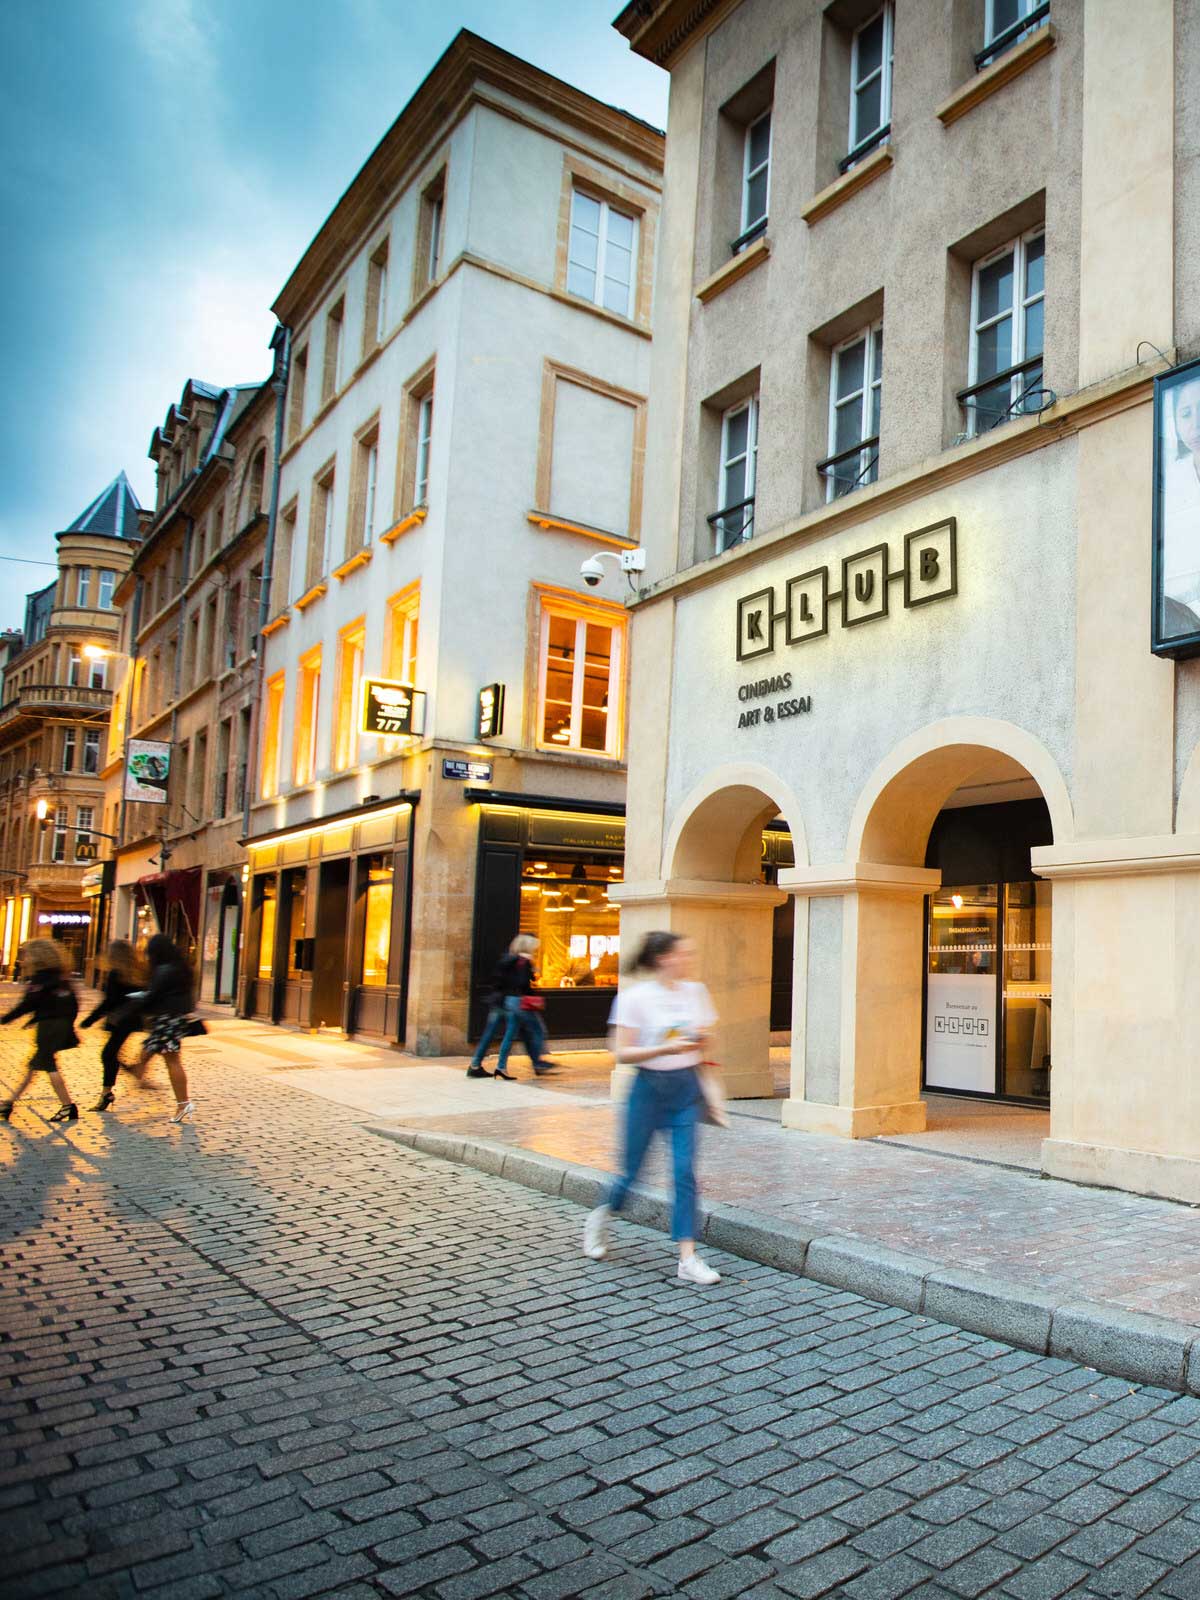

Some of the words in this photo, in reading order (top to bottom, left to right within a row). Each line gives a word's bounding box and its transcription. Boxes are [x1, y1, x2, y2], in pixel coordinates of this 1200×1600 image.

[743, 539, 947, 648] KLUB
[738, 672, 793, 702] CINEMAS
[375, 718, 401, 732] 7/7
[738, 706, 762, 729] ART
[763, 706, 775, 723] &
[777, 695, 812, 719] ESSAI
